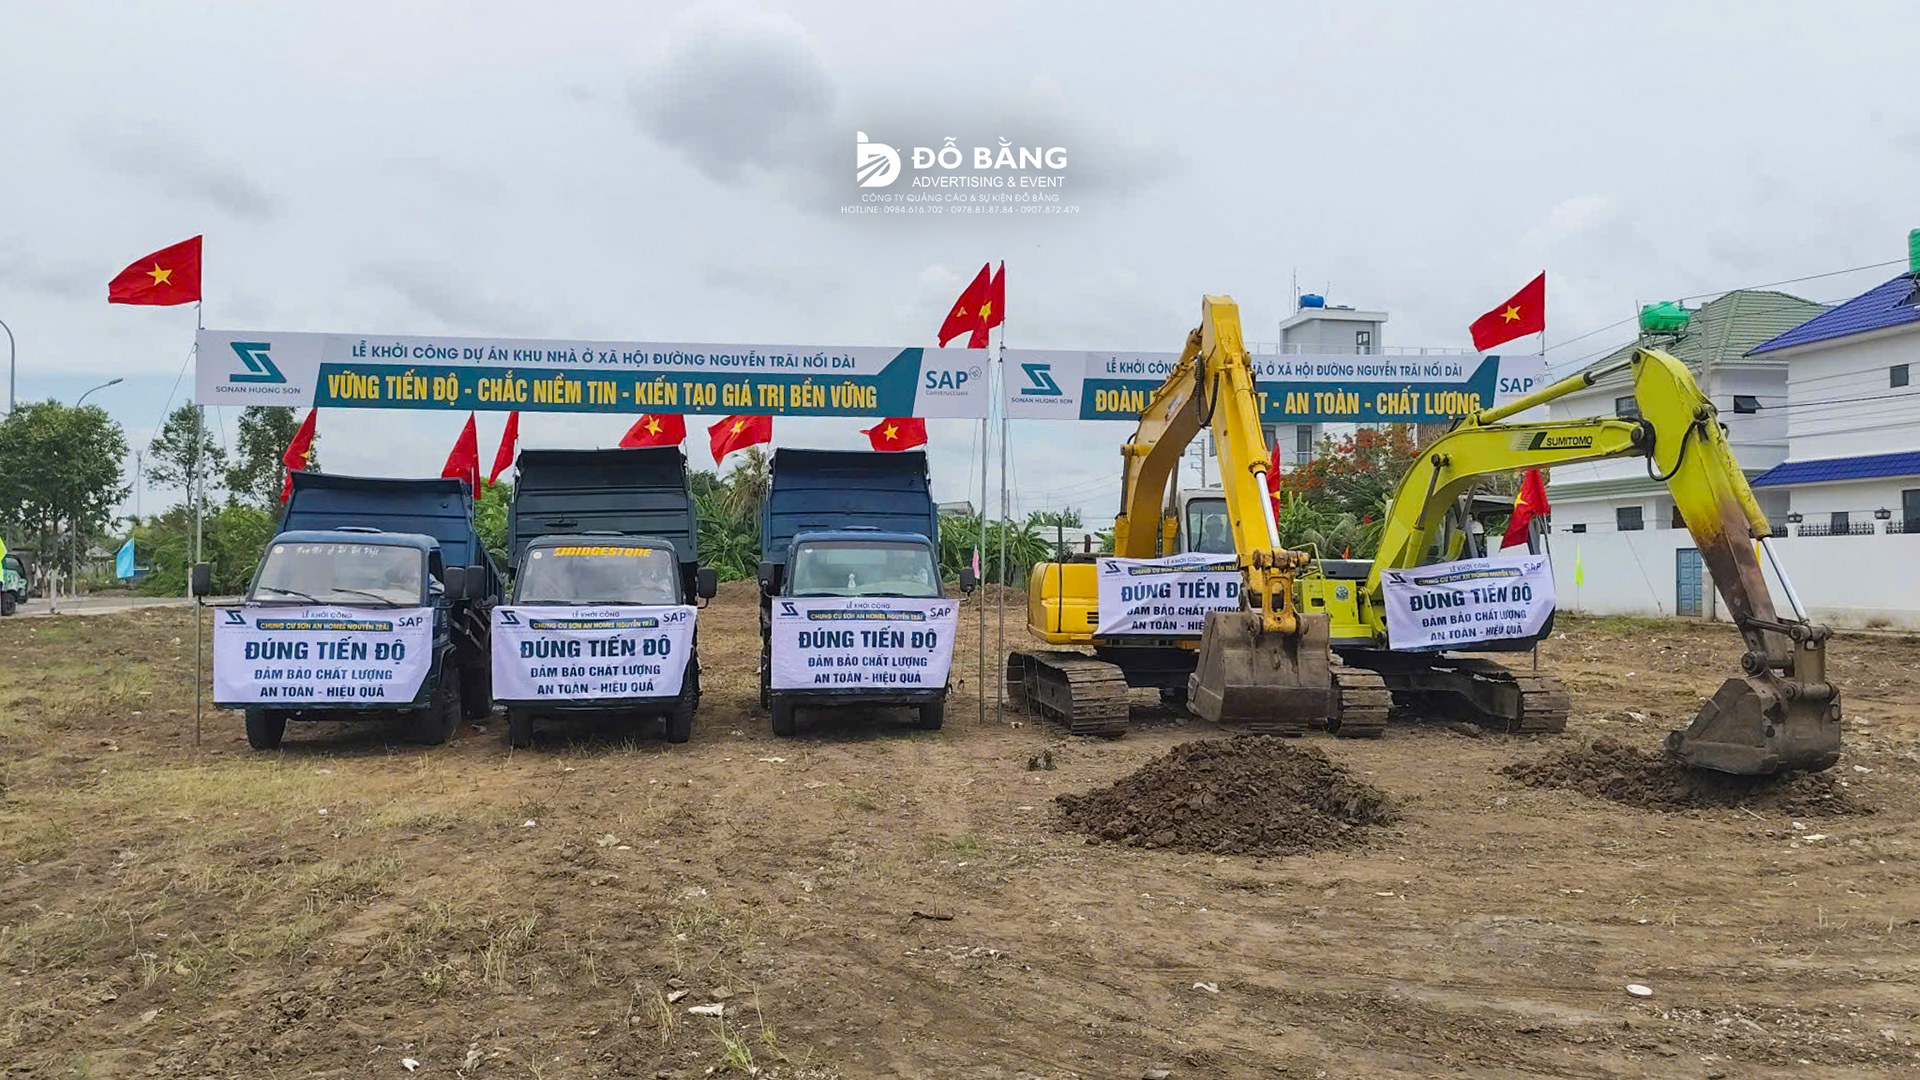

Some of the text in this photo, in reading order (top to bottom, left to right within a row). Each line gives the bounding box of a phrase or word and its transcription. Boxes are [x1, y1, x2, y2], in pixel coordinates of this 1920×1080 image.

[352, 340, 855, 368] LỄ KHỞI CÔNG DỰ ÁN KHU NHÀ Ở XÃ HỘI ĐƯỜNG NGUYỄN TRÃI NỐI DÀI
[1106, 357, 1116, 374] LỄ
[1120, 359, 1144, 374] KHỞI
[1278, 362, 1292, 376] XÃ
[1295, 362, 1313, 379] HỘI
[1316, 362, 1354, 376] ĐƯỜNG
[1357, 360, 1396, 376] NGUYỄN
[1400, 363, 1420, 376] TRÃI
[1424, 361, 1442, 376] NỐI
[1446, 362, 1462, 376] DÀI
[926, 370, 968, 390] SAP
[1500, 377, 1534, 394] SAP
[248, 386, 280, 394] HUONG
[282, 386, 301, 394] SON
[328, 370, 380, 400] VỮNG
[385, 368, 428, 400] TIẾN
[432, 372, 459, 406] ĐỘ
[477, 370, 528, 402] CHẮC
[533, 372, 582, 404] NIỀM
[586, 380, 617, 405] TIN
[634, 374, 678, 406] KIẾN
[682, 382, 717, 411] TẠO
[722, 378, 752, 407] GIÁ
[757, 384, 785, 412] TRỊ
[790, 377, 825, 408] BỀN
[830, 380, 878, 408] VỮNG
[1095, 386, 1144, 412] ĐOÀN
[1284, 392, 1309, 414] AN
[1314, 388, 1359, 414] TOÀN
[1376, 385, 1420, 415] CHẤT
[1425, 390, 1480, 419] LƯỢNG
[1546, 436, 1593, 446] SUMITOMO
[554, 547, 653, 557] BRIDGESTONE
[1523, 562, 1542, 572] SAP
[1121, 576, 1220, 602] ĐÚNG TIẾN
[1410, 582, 1533, 611] ĐÚNG TIẾN ĐỘ
[663, 612, 686, 623] SAP
[930, 607, 951, 617] SAP
[1153, 603, 1175, 616] BẢO
[1422, 608, 1526, 627] ĐẢM BẢO CHẤT LƯỢNG
[398, 617, 424, 627] SAP
[1132, 620, 1177, 630] AN TOÀN
[798, 625, 937, 653] ĐÚNG TIẾN ĐỘ
[1430, 631, 1445, 641] AN
[1448, 627, 1476, 638] TOÀN
[1506, 622, 1522, 634] QUẢ
[244, 636, 406, 664] ĐÚNG TIẾN ĐỘ
[520, 634, 671, 660] ĐÚNG TIẾN ĐỘ
[808, 653, 928, 669] ĐẢM BẢO CHẤT LƯỢNG
[254, 666, 392, 682] ĐẢM BẢO CHẤT LƯỢNG
[530, 663, 661, 678] ĐẢM BẢO CHẤT LƯỢNG
[814, 670, 921, 685] AN TOÀN HIỆU QUẢ
[260, 684, 384, 699] AN TOÀN HIỆU QUẢ
[537, 678, 654, 695] AN TOÀN HIỆU QUẢ
